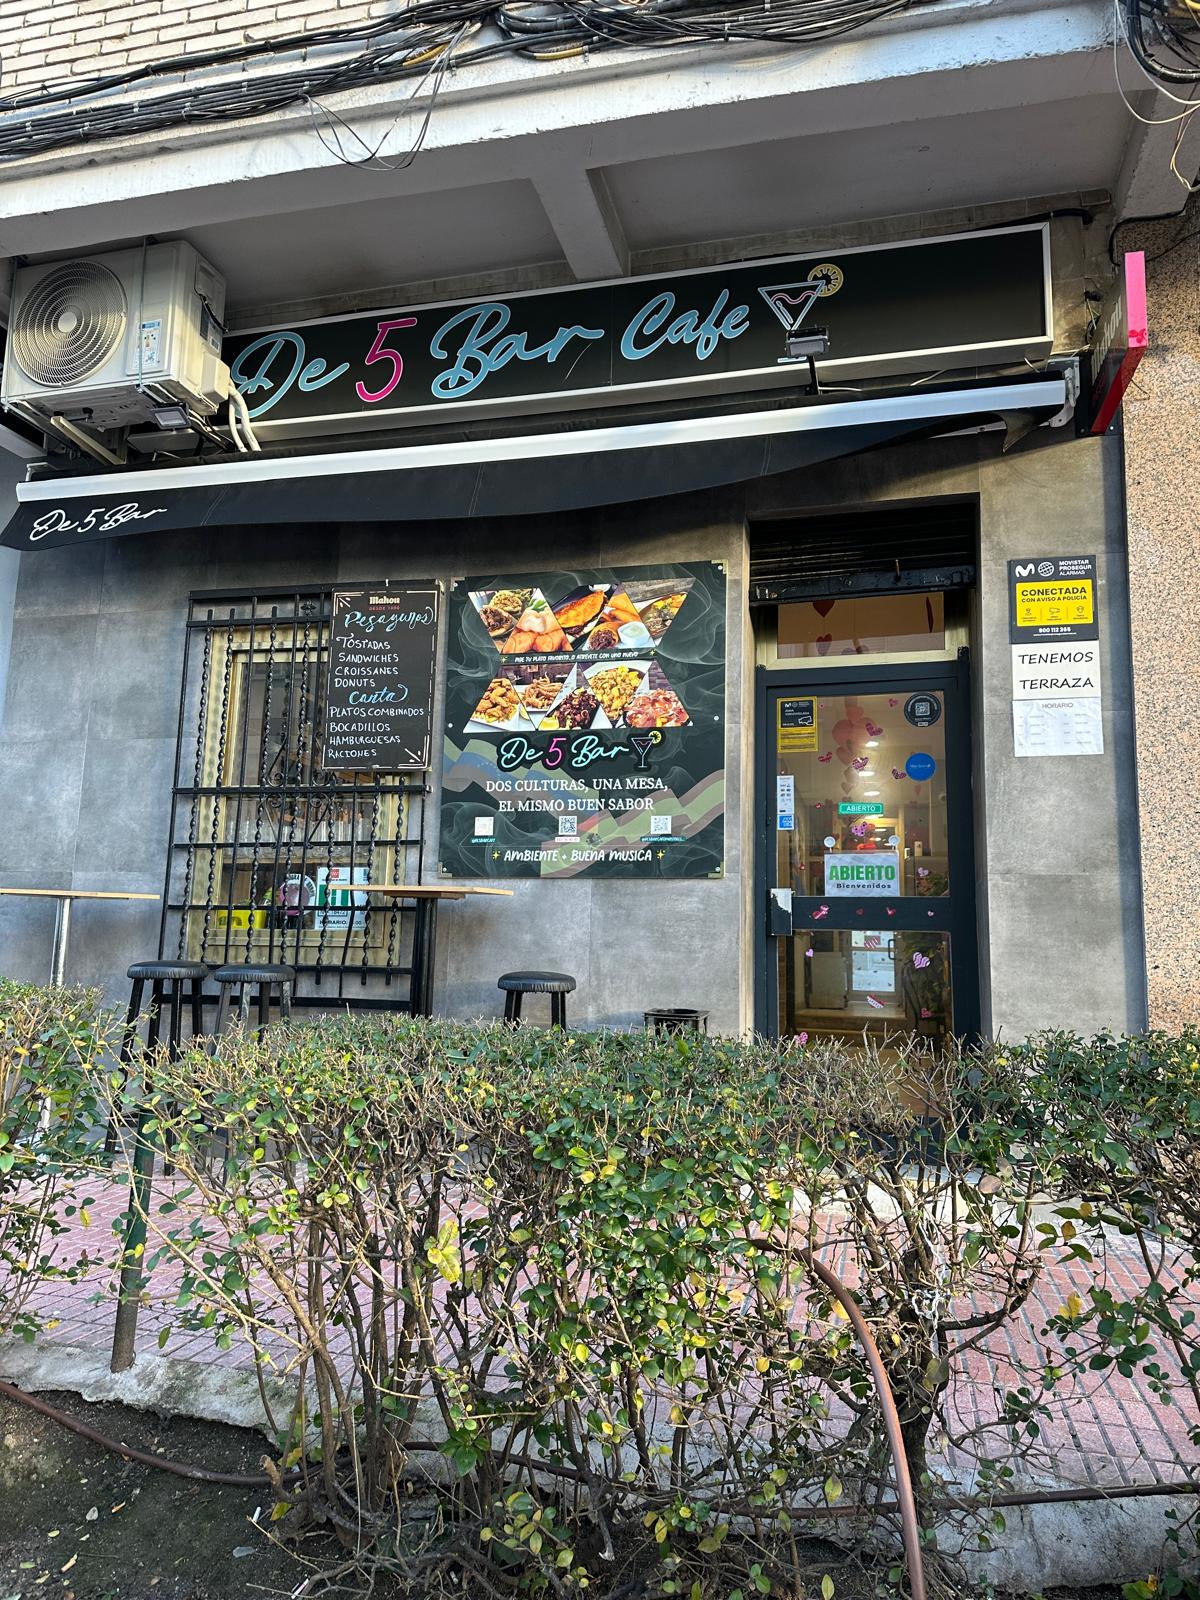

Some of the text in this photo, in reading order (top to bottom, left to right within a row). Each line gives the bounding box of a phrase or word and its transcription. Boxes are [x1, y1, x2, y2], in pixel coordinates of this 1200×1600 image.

[230, 288, 751, 418] De 5 Bar Cafe
[29, 502, 168, 541] De 5 Bar
[1021, 587, 1087, 596] CONECTADA
[369, 595, 400, 605] Mahou
[336, 633, 391, 650] TOSTADAS
[338, 652, 399, 663] SANDWICHES
[1018, 651, 1094, 665] TENEMOS
[335, 666, 399, 676] CROISSANES
[334, 678, 376, 688] DONUTS
[1019, 677, 1094, 689] TERRAZA
[349, 684, 409, 704] Carta
[329, 706, 424, 717] PLATOS COMBINADOS
[330, 722, 391, 732] BOCADILLOS
[329, 735, 401, 745] HAMBURGUESAS
[327, 748, 377, 758] RACIONES
[500, 735, 629, 767] De 5 Bar
[485, 777, 668, 794] DOS CULTURAS, UNA MESA,
[499, 798, 654, 812] EL MISMO BUEN SABOR
[846, 804, 876, 812] ABIERTO
[503, 849, 652, 861] AMBIENTE BUENA MUSICA
[829, 865, 896, 881] ABIERTO
